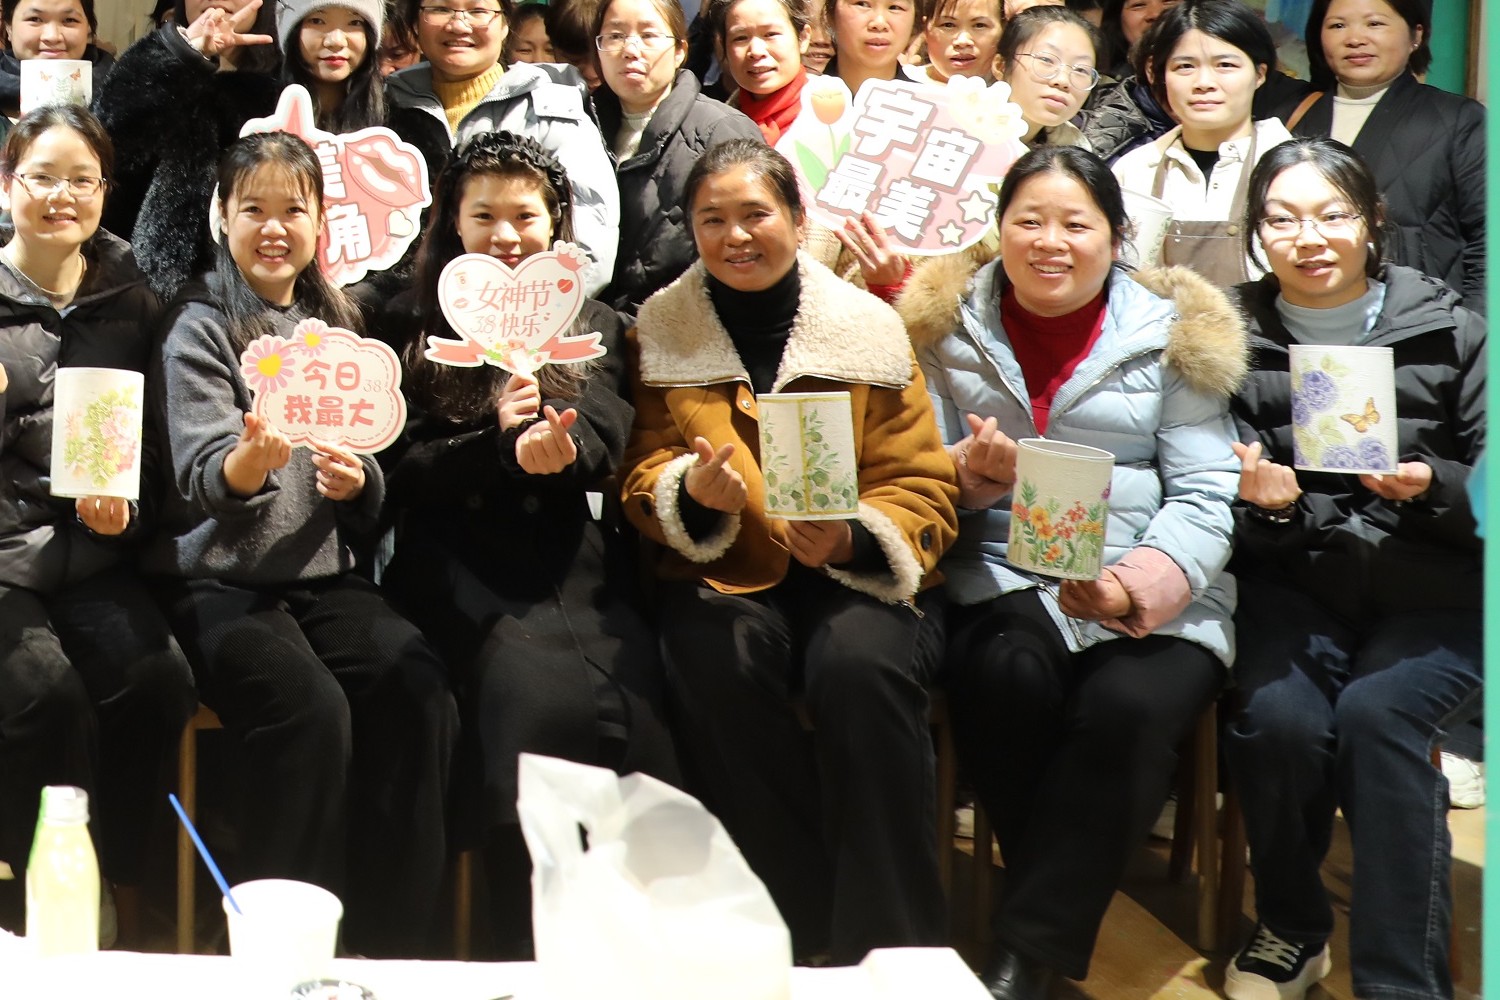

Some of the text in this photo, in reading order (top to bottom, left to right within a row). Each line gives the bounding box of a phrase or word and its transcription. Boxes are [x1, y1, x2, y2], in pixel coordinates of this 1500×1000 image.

[853, 87, 984, 195] 宇宙
[815, 152, 943, 248] 最美
[462, 279, 555, 314] 女神节
[499, 312, 542, 338] 快乐
[301, 359, 362, 392] 今日
[283, 394, 376, 428] 我最大
